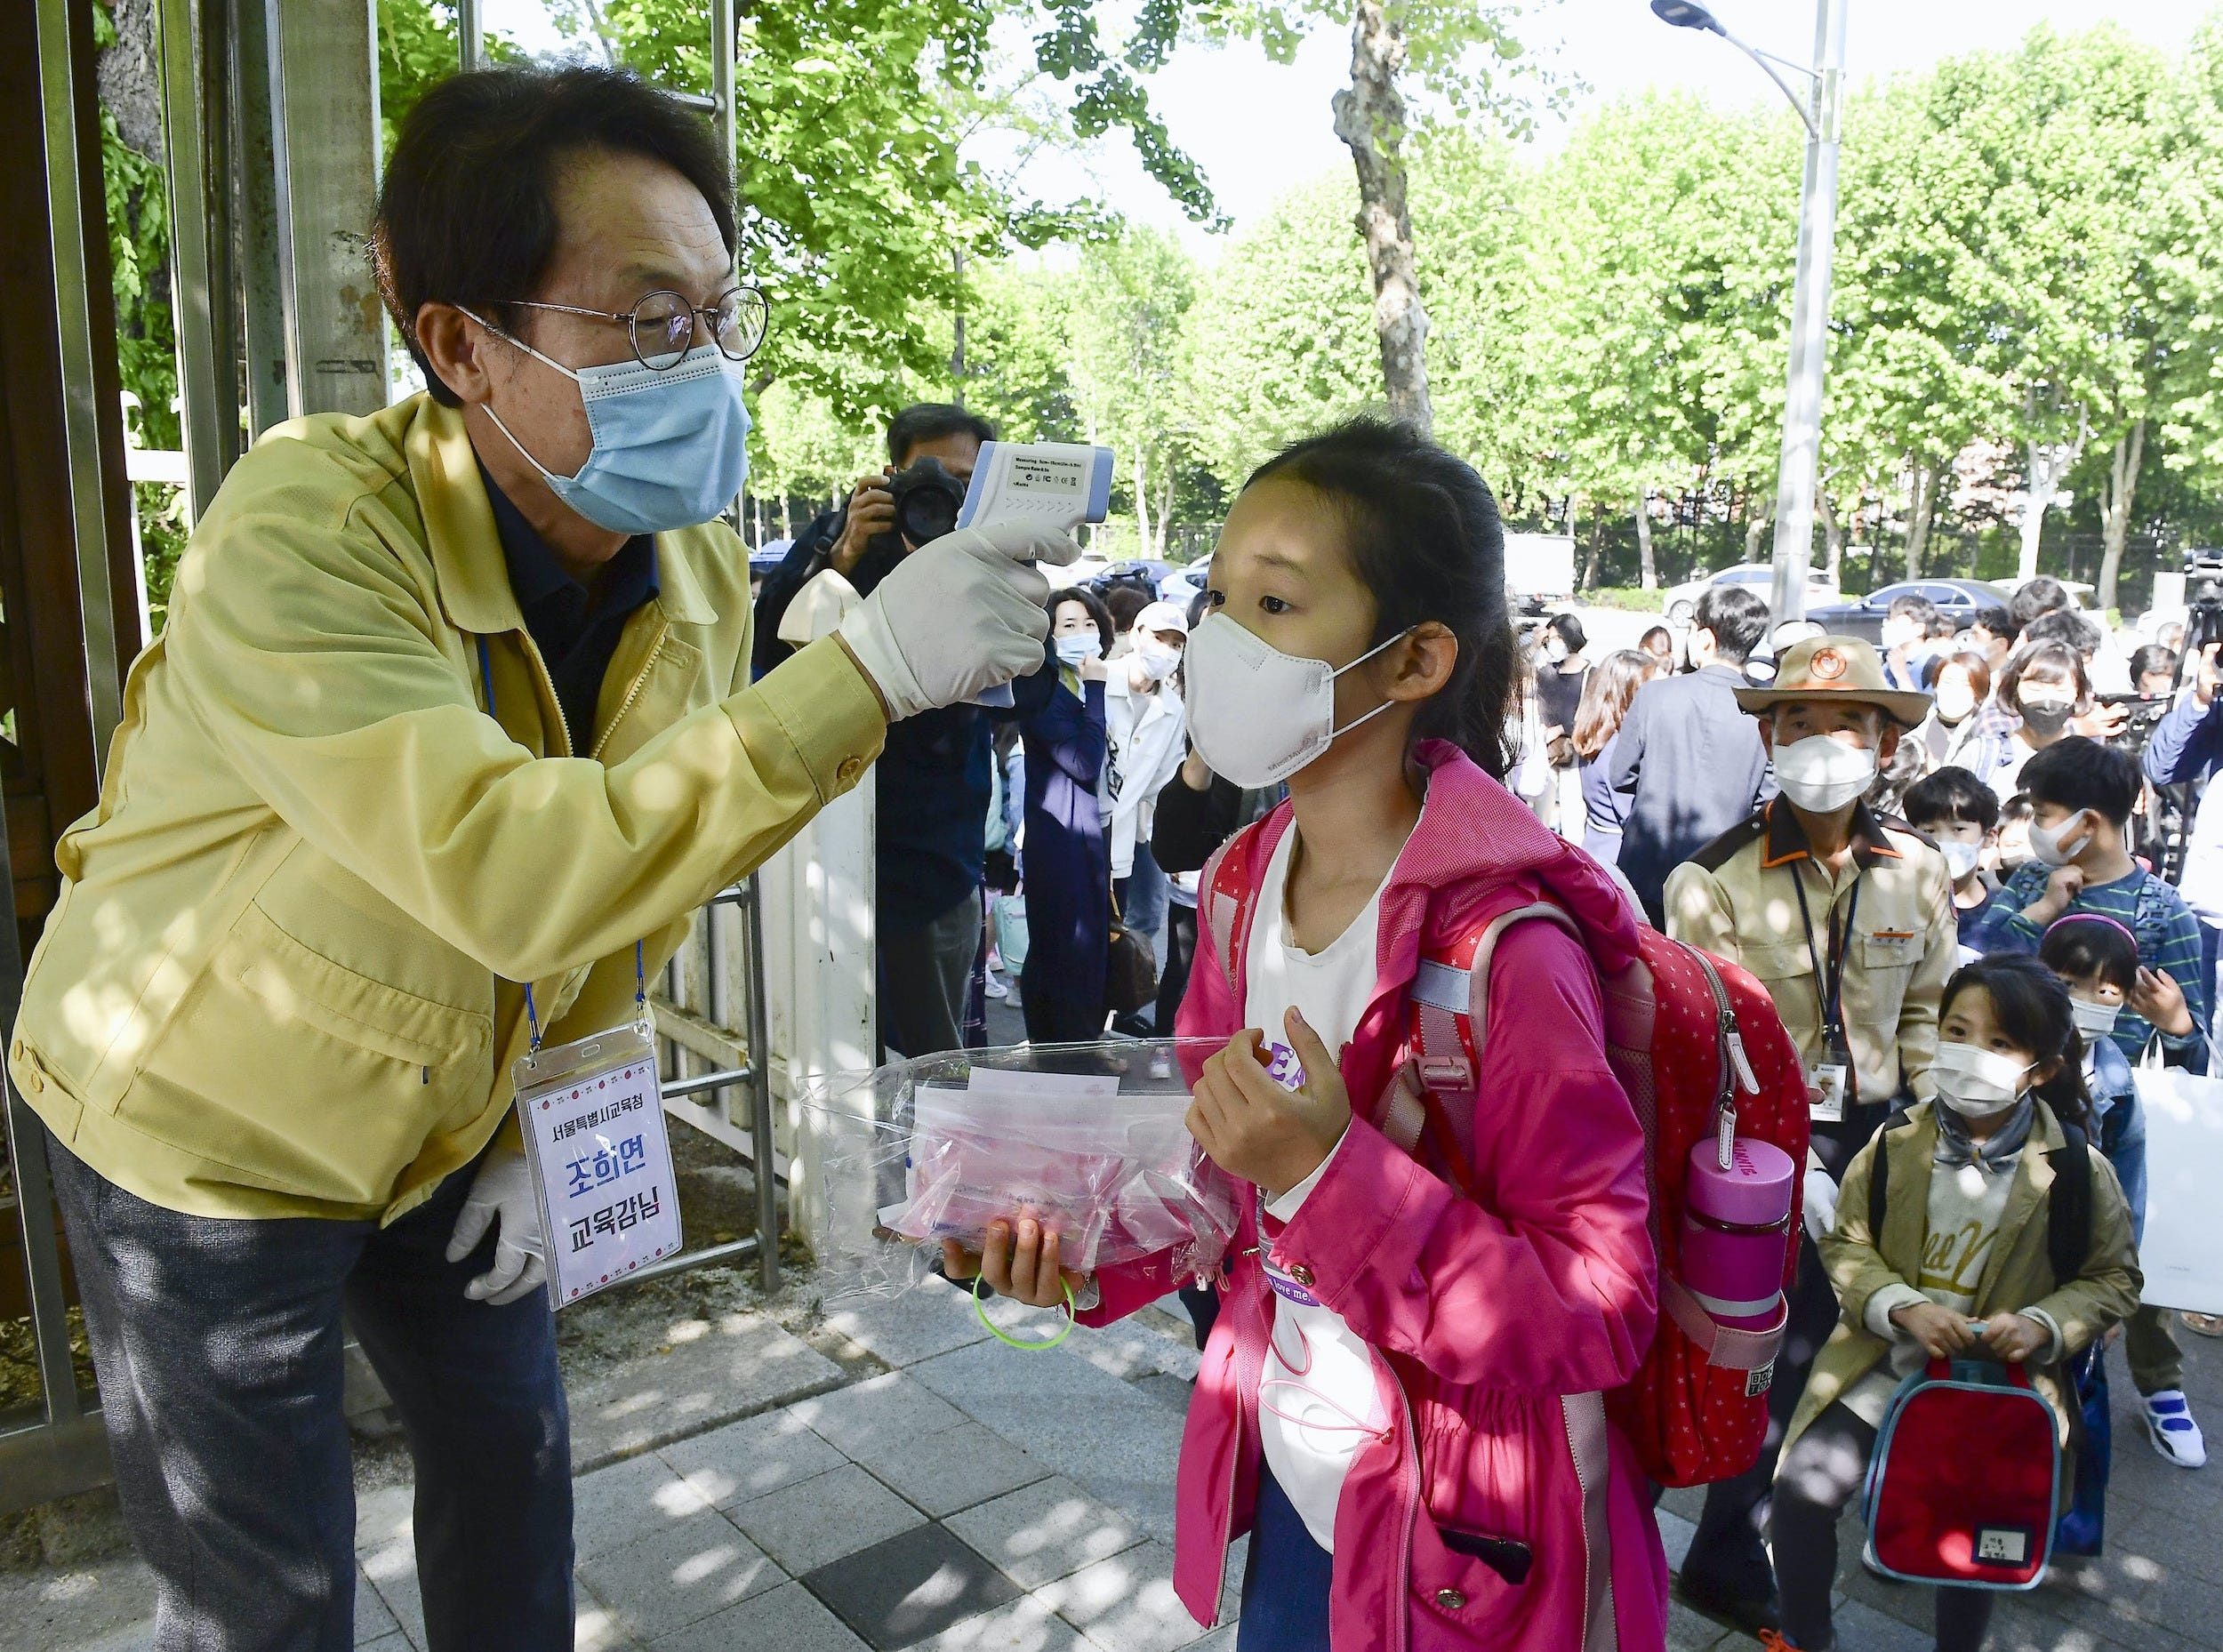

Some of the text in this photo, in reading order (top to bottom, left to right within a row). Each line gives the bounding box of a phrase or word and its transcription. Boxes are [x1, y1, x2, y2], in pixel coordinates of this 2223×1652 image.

[551, 1093, 644, 1143] 서울특별시교육청
[566, 1134, 646, 1199] 조희연
[569, 1185, 661, 1253] 교육감님
[1272, 1279, 1291, 1295] love
[1293, 1289, 1312, 1303] me.
